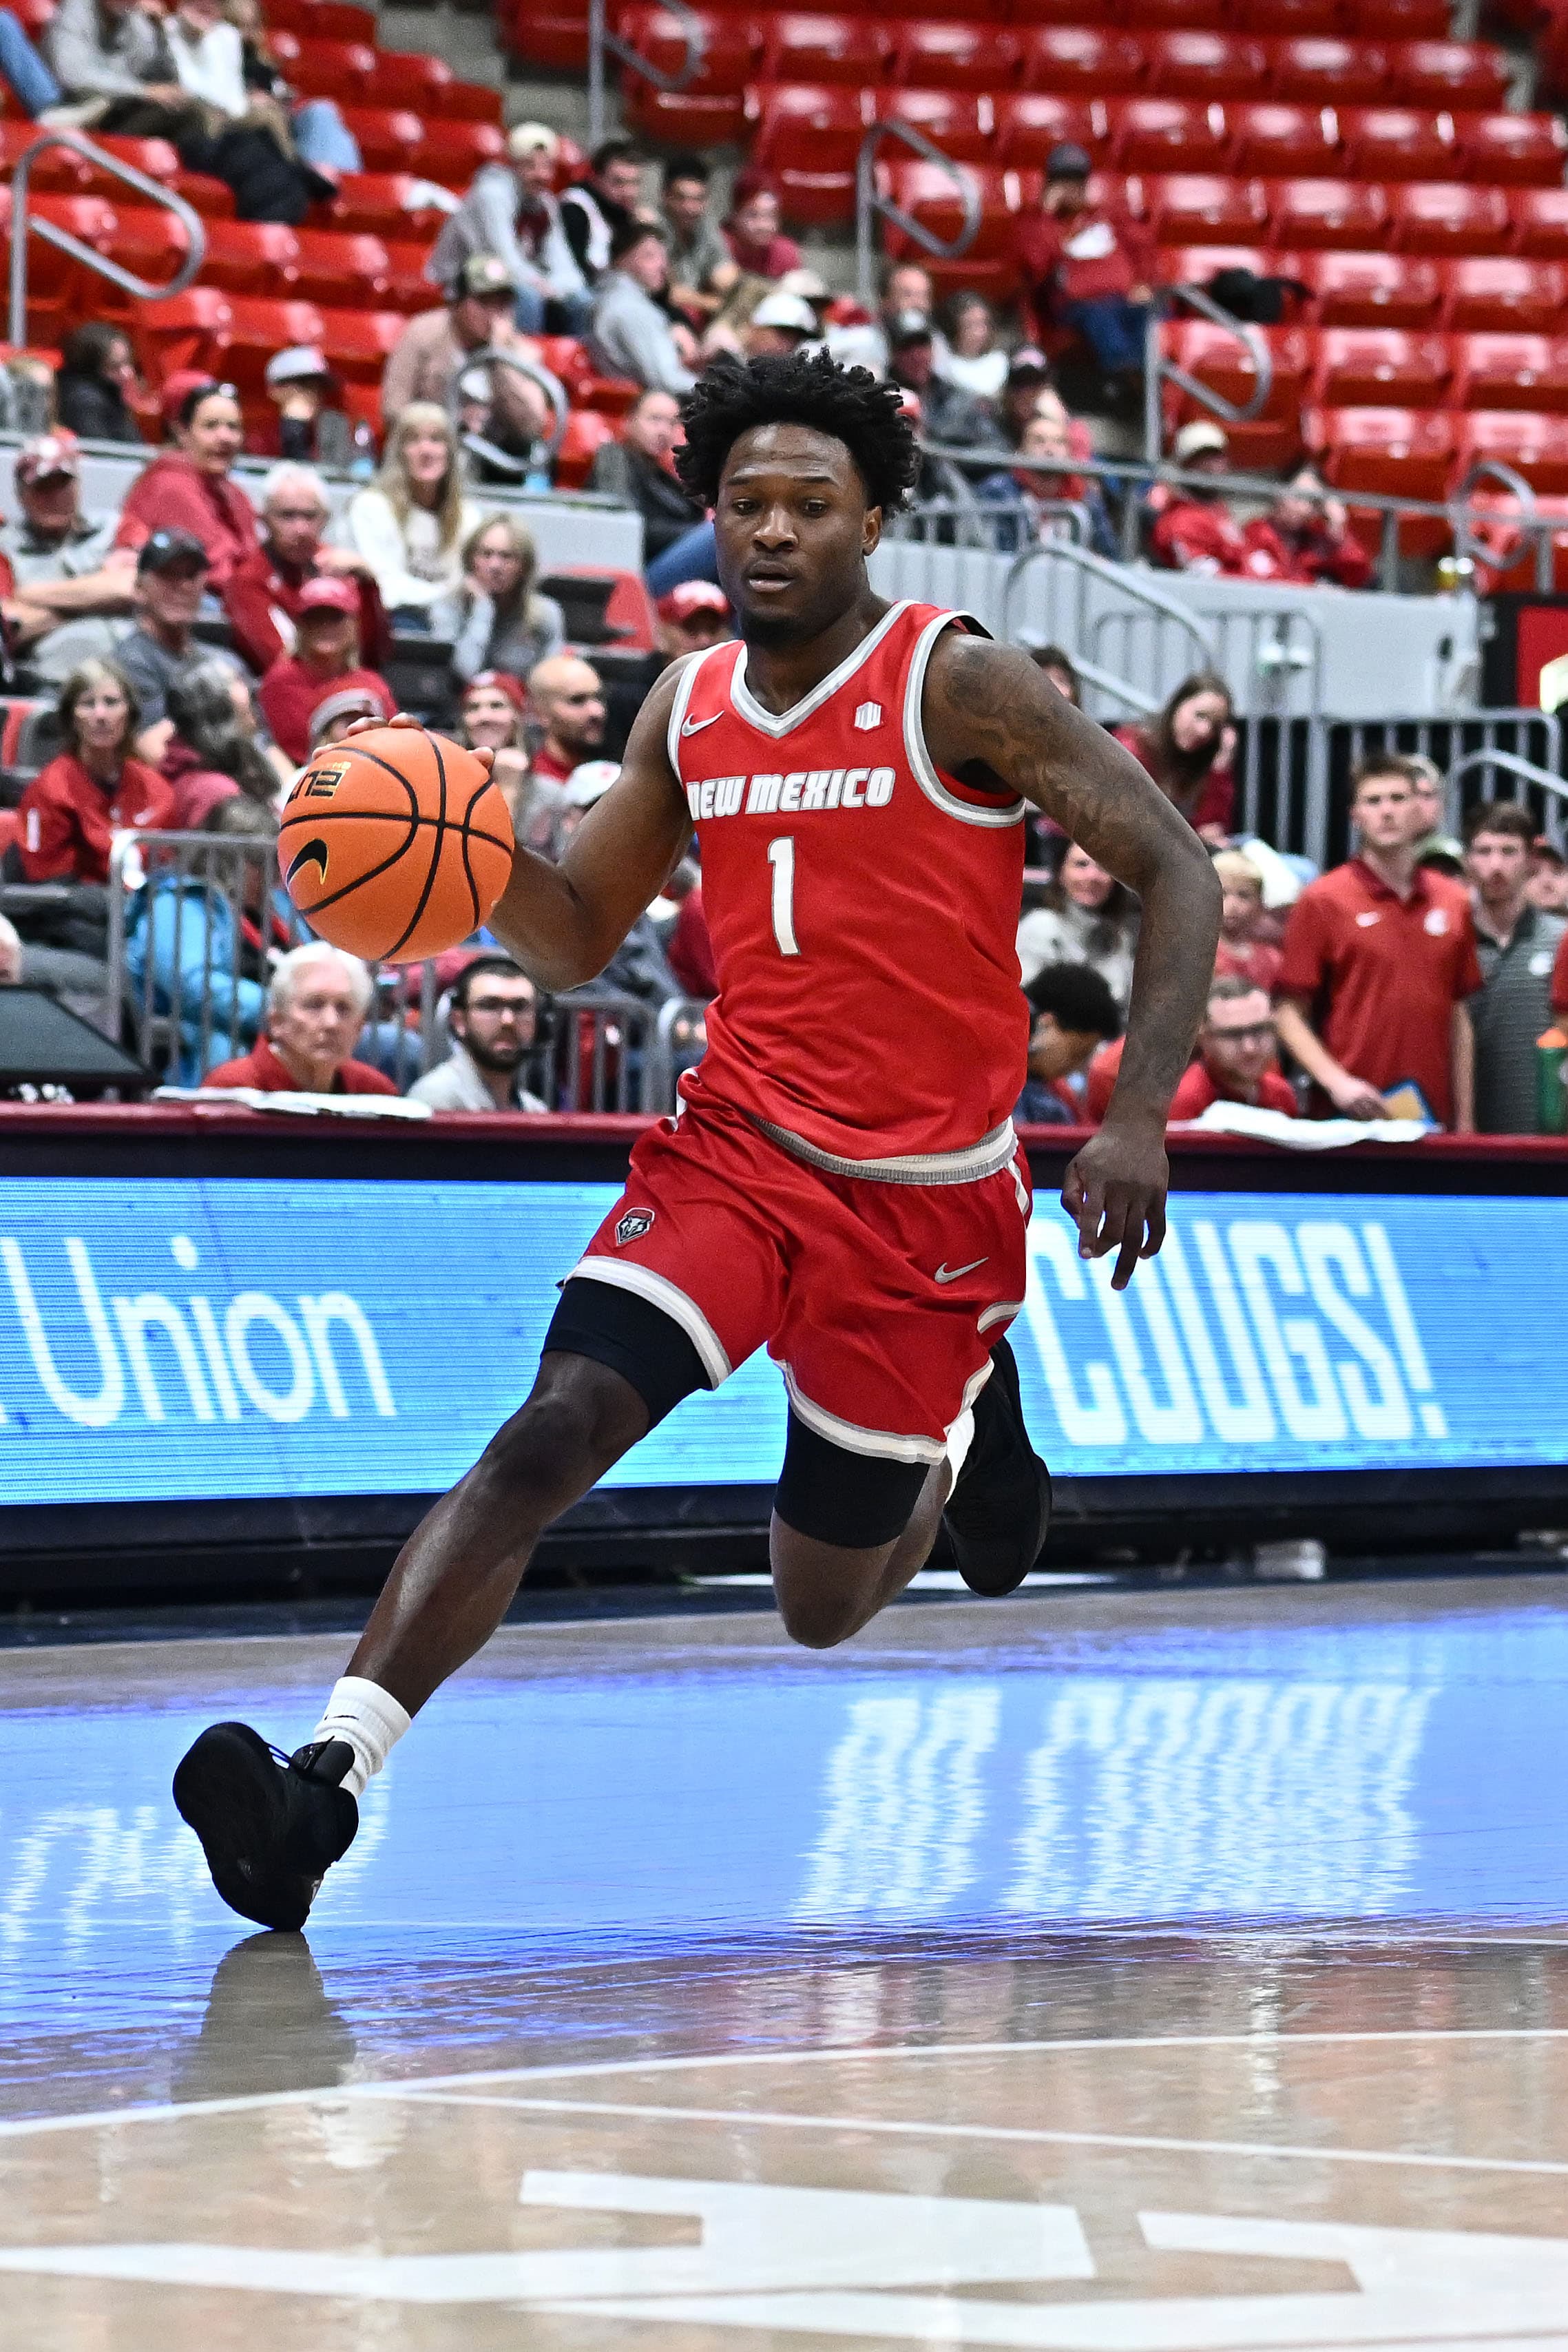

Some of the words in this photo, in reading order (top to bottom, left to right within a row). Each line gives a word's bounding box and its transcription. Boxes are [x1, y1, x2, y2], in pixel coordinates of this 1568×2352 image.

[687, 776, 746, 822] NEW
[745, 767, 896, 814] MEXICO
[767, 835, 802, 956] 1
[0, 1234, 397, 1428] Union
[1023, 1219, 1449, 1446] COUGS!
